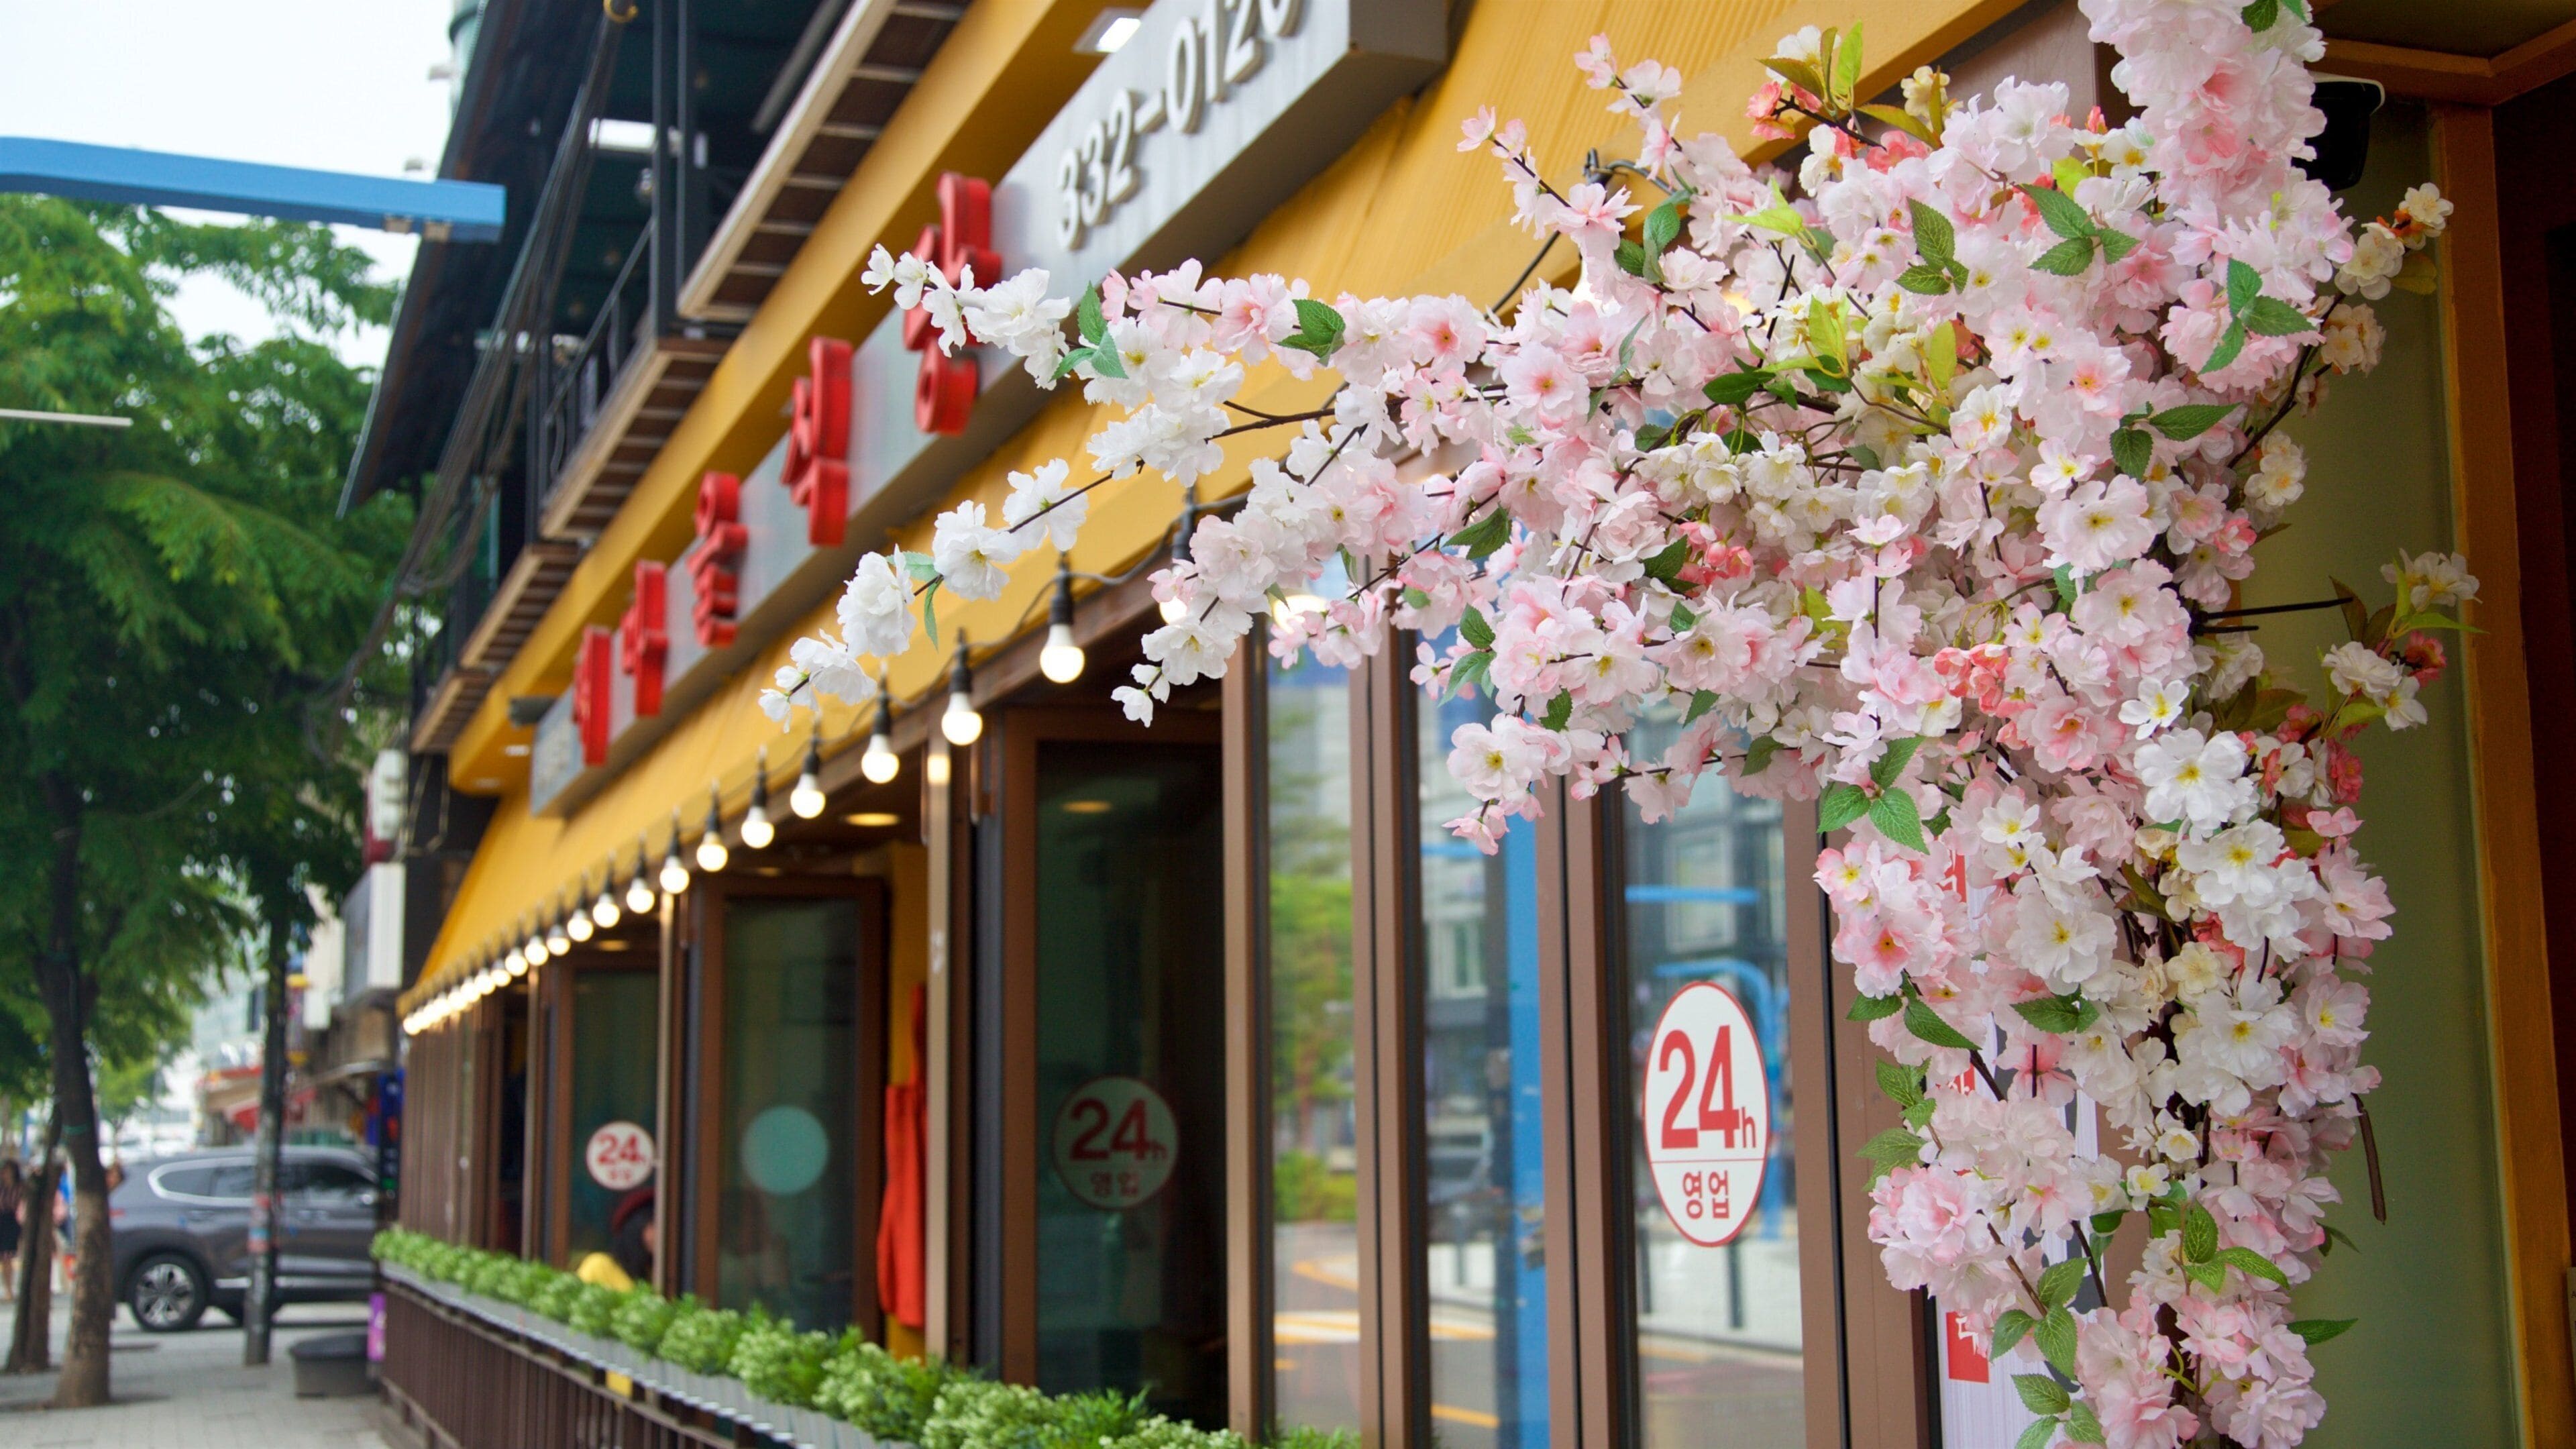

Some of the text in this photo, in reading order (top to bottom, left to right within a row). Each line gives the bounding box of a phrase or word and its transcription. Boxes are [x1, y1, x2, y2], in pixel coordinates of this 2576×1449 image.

[1057, 0, 1300, 252] 332-012
[1069, 1097, 1168, 1162] 24h
[1659, 1025, 1756, 1149] 24h
[1682, 1170, 1730, 1220] 영업
